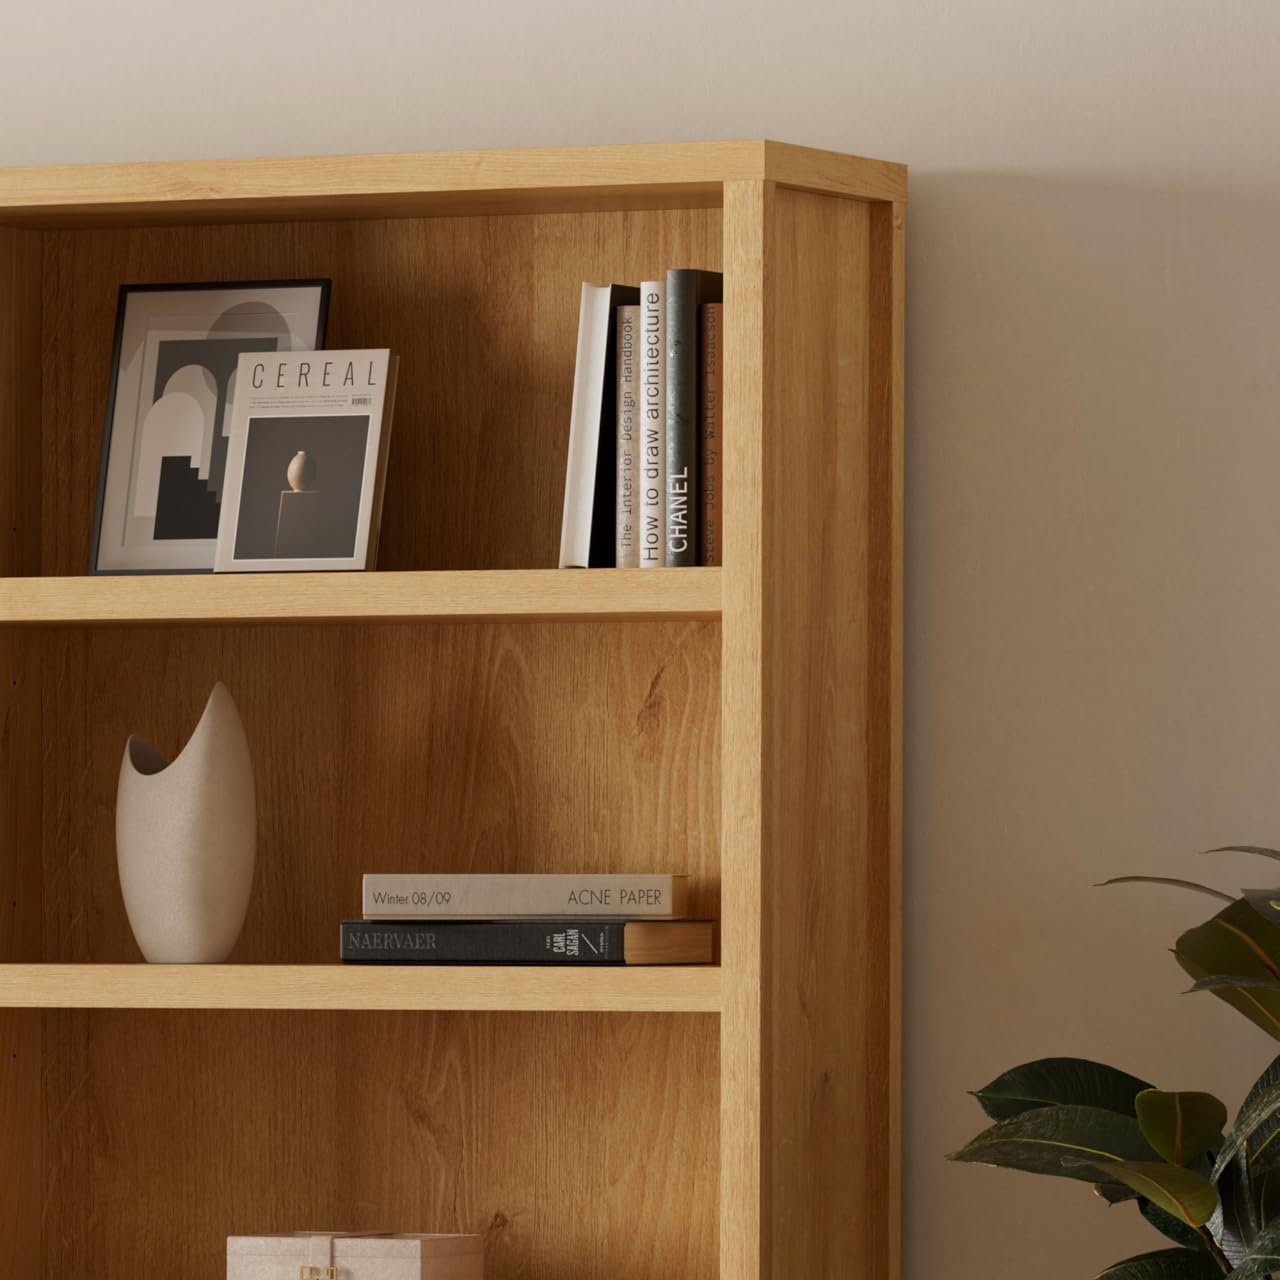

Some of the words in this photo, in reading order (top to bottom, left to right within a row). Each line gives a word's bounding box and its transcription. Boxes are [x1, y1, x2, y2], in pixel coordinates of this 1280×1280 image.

[621, 315, 633, 383] Handbook
[644, 292, 660, 420] architecture
[252, 360, 376, 389] CEREAL
[622, 391, 635, 441] Design
[643, 428, 659, 479] draw
[621, 450, 632, 515] Interior
[644, 488, 659, 507] to
[670, 466, 688, 552] CHANEL
[621, 523, 632, 547] The
[643, 515, 659, 561] How
[372, 891, 408, 905] Winter
[411, 891, 452, 907] 08/09
[567, 889, 611, 905] ACNE
[620, 889, 661, 905] PAPER
[348, 932, 436, 950] NAERVAER
[553, 932, 565, 952] CARL
[566, 929, 579, 956] SAGAN
